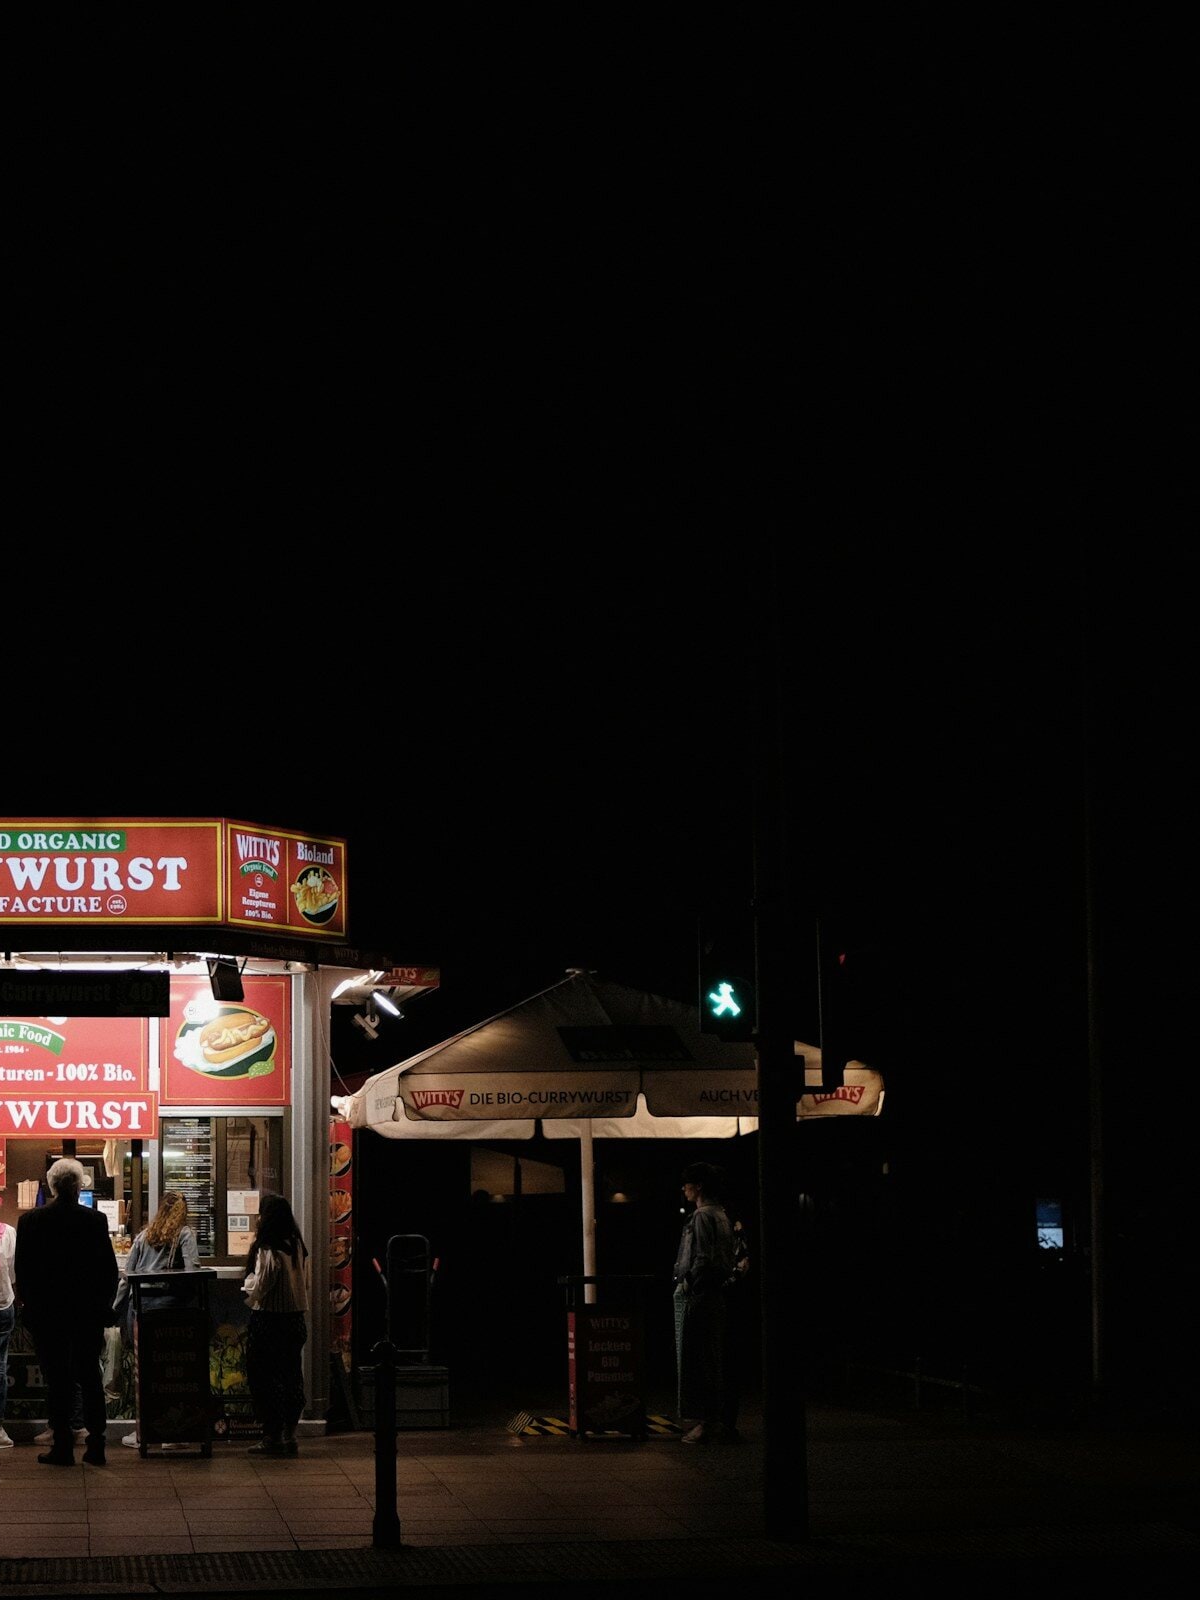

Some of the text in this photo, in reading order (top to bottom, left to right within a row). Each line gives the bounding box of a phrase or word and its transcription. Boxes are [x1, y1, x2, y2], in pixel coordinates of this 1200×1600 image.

[17, 832, 121, 850] ORGANIC
[235, 834, 280, 867] WITTY'S
[296, 842, 334, 865] Bioland
[249, 888, 269, 899] Eigene
[242, 897, 276, 909] Rezepturen
[19, 1025, 52, 1046] Food
[103, 1063, 136, 1082] Bio.
[413, 1090, 461, 1108] WITTY'S
[470, 1093, 493, 1105] DIE
[497, 1091, 632, 1105] BIO-CURRYWURST
[699, 1090, 740, 1102] AUCH
